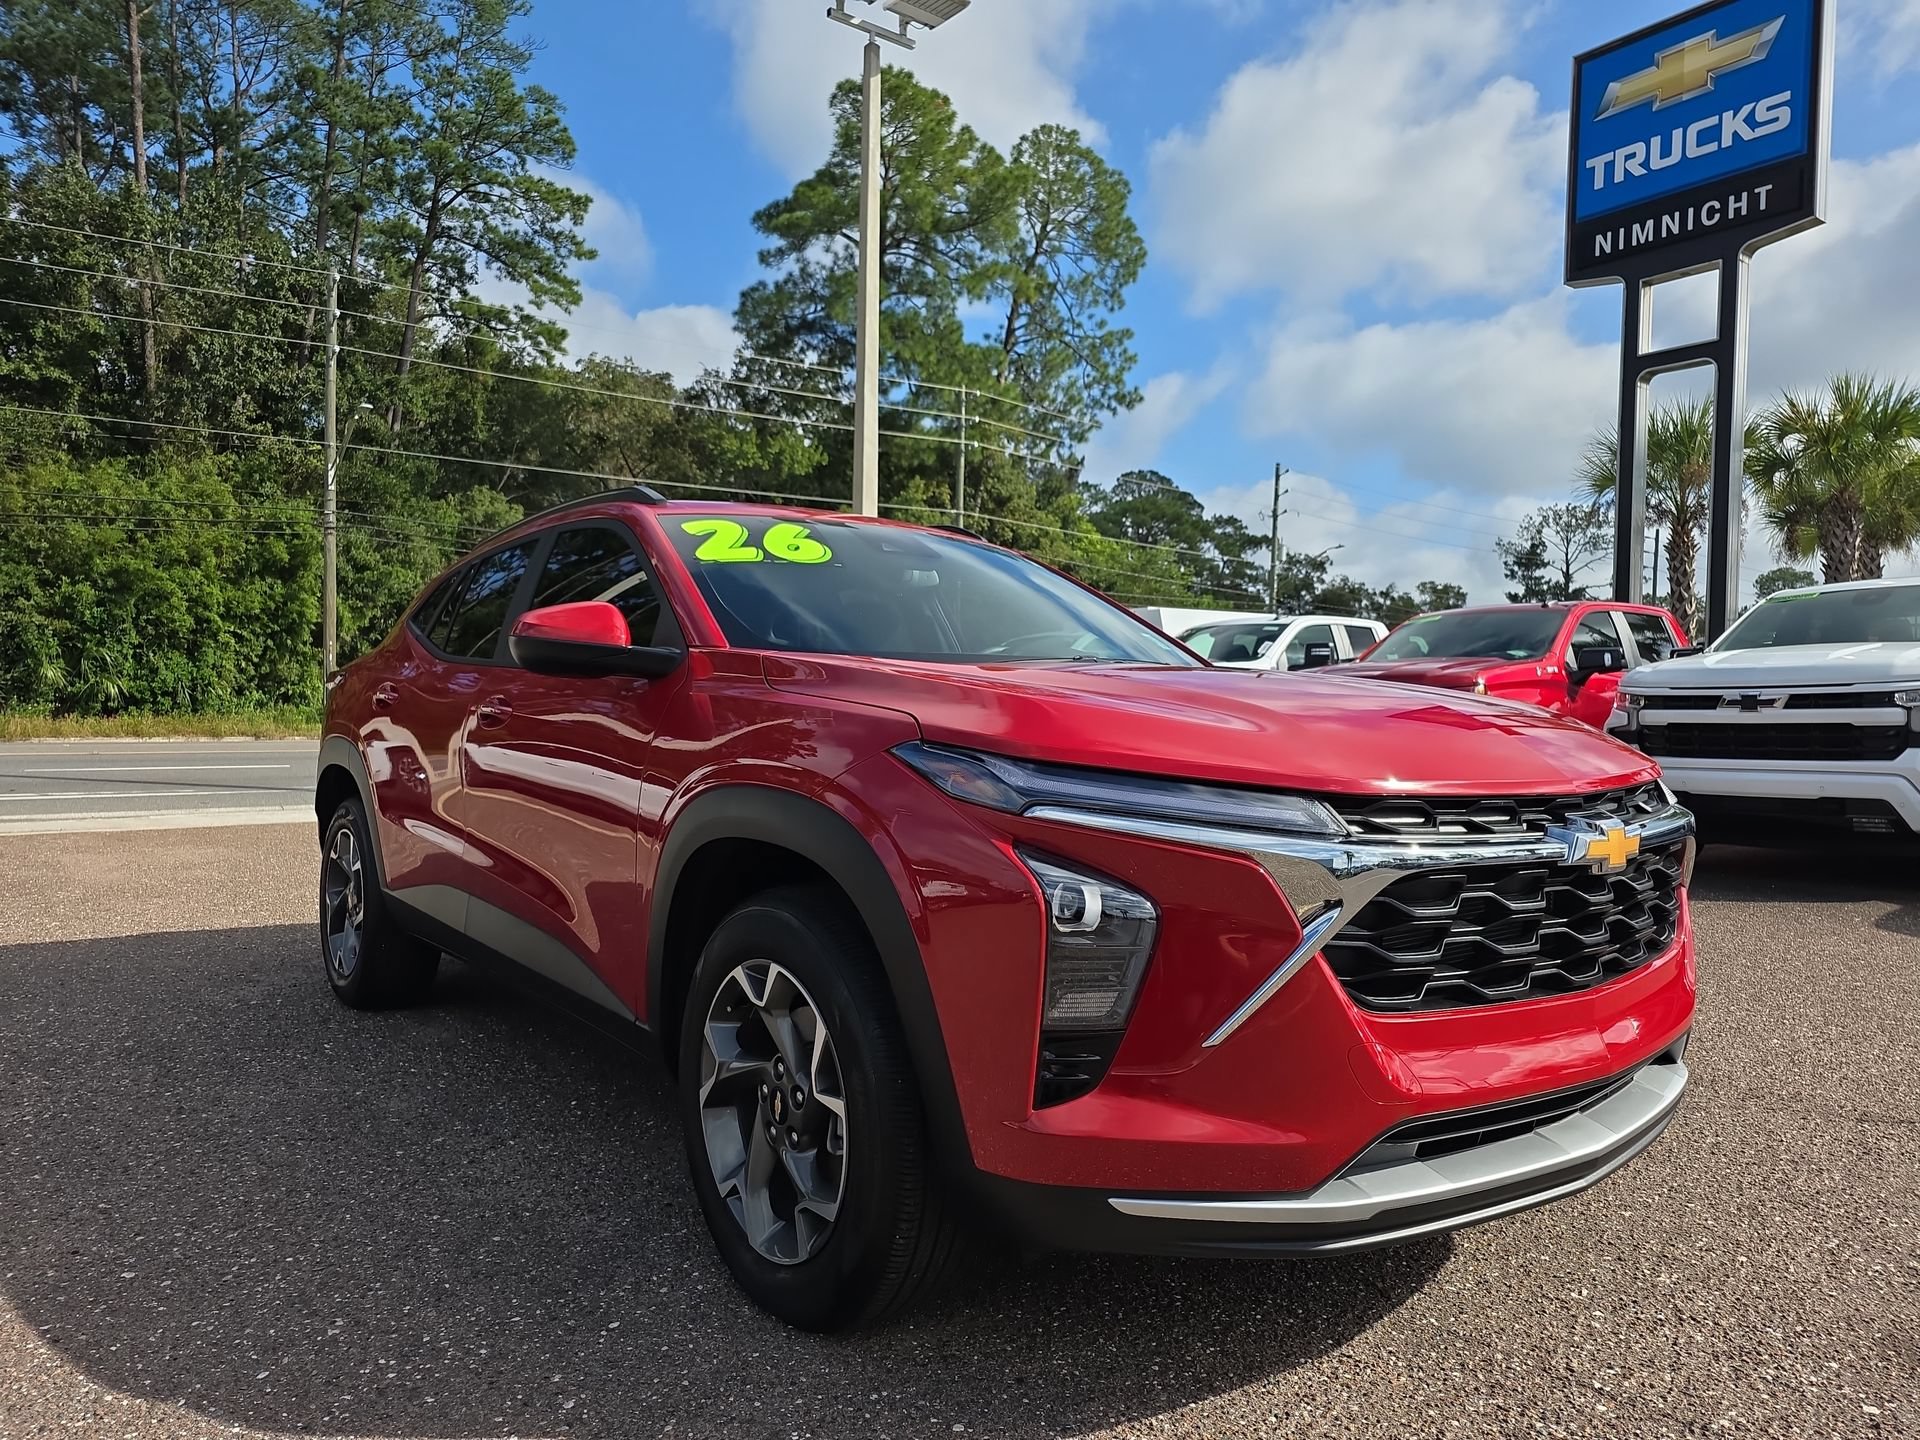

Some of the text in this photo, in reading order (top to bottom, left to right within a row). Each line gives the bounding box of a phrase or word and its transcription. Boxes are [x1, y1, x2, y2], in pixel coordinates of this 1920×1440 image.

[1586, 90, 1791, 190] TRUCKS
[1595, 184, 1773, 257] NIMNICHT
[681, 519, 832, 563] 26
